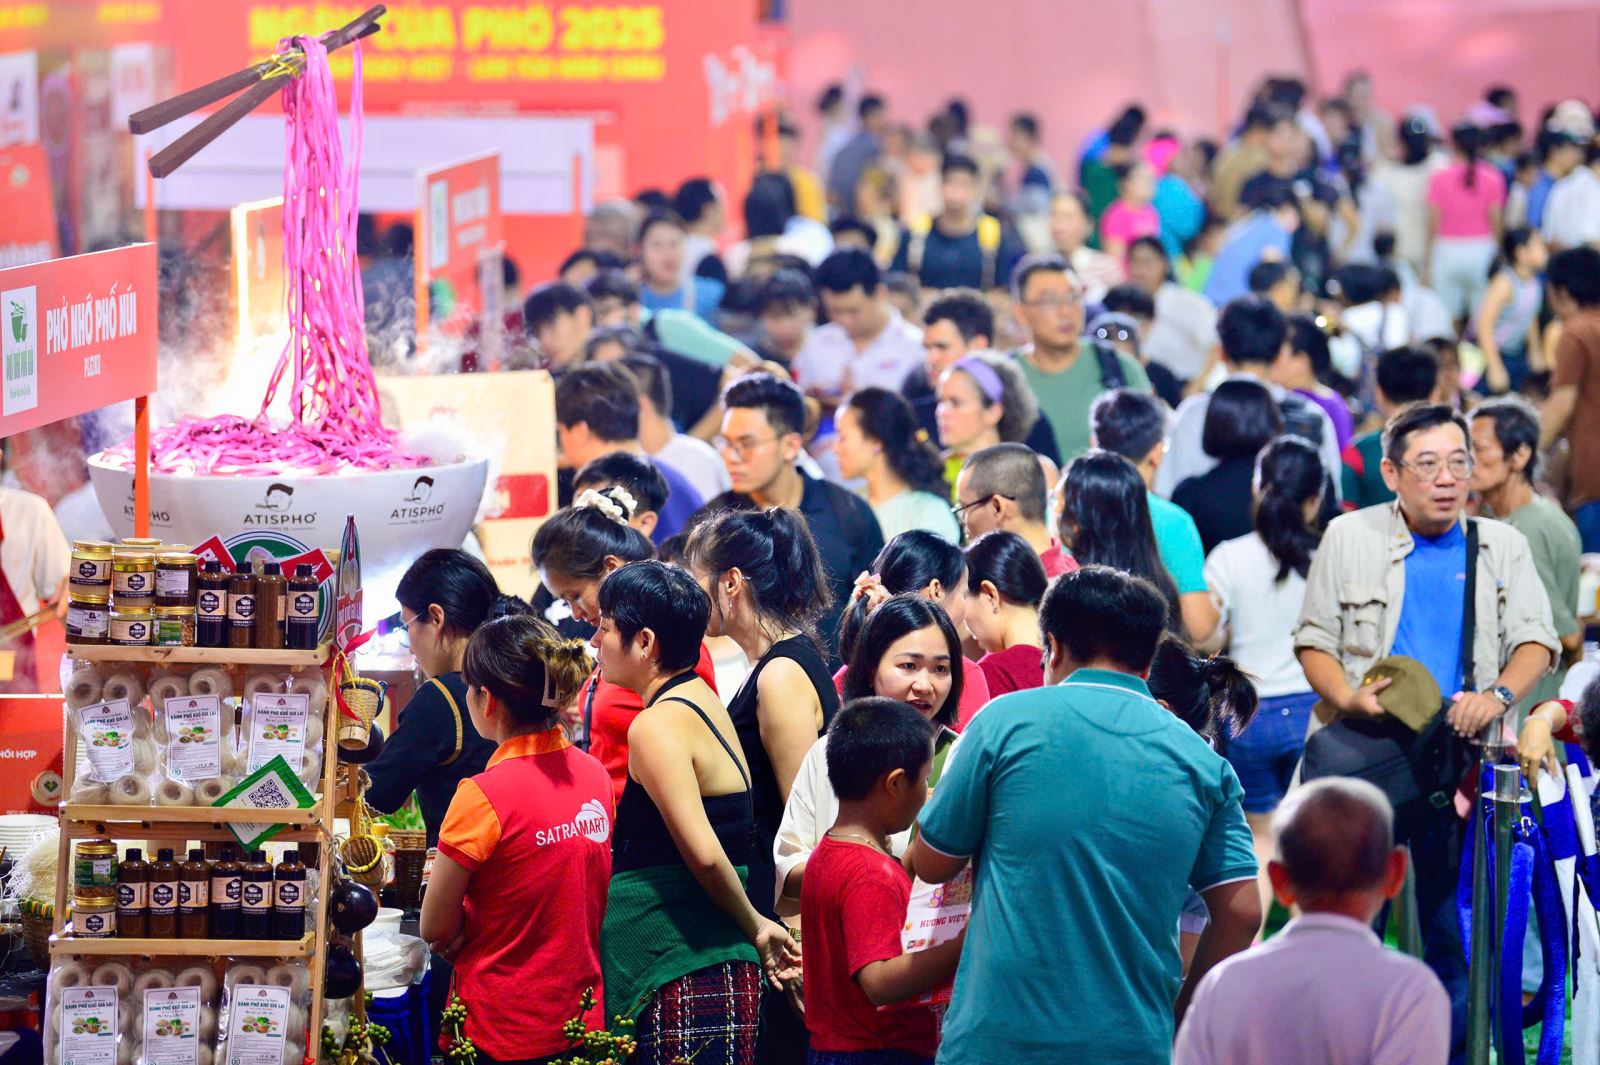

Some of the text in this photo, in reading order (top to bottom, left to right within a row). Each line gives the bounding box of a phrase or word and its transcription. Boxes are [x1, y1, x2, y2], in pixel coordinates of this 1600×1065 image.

[559, 6, 665, 50] 2025
[46, 296, 68, 354] PHỞ
[96, 280, 118, 342] PHỐ
[119, 284, 136, 336] NÚI
[124, 505, 170, 521] ATHO
[244, 514, 315, 524] ATISPHO
[390, 504, 444, 518] ATISPHO
